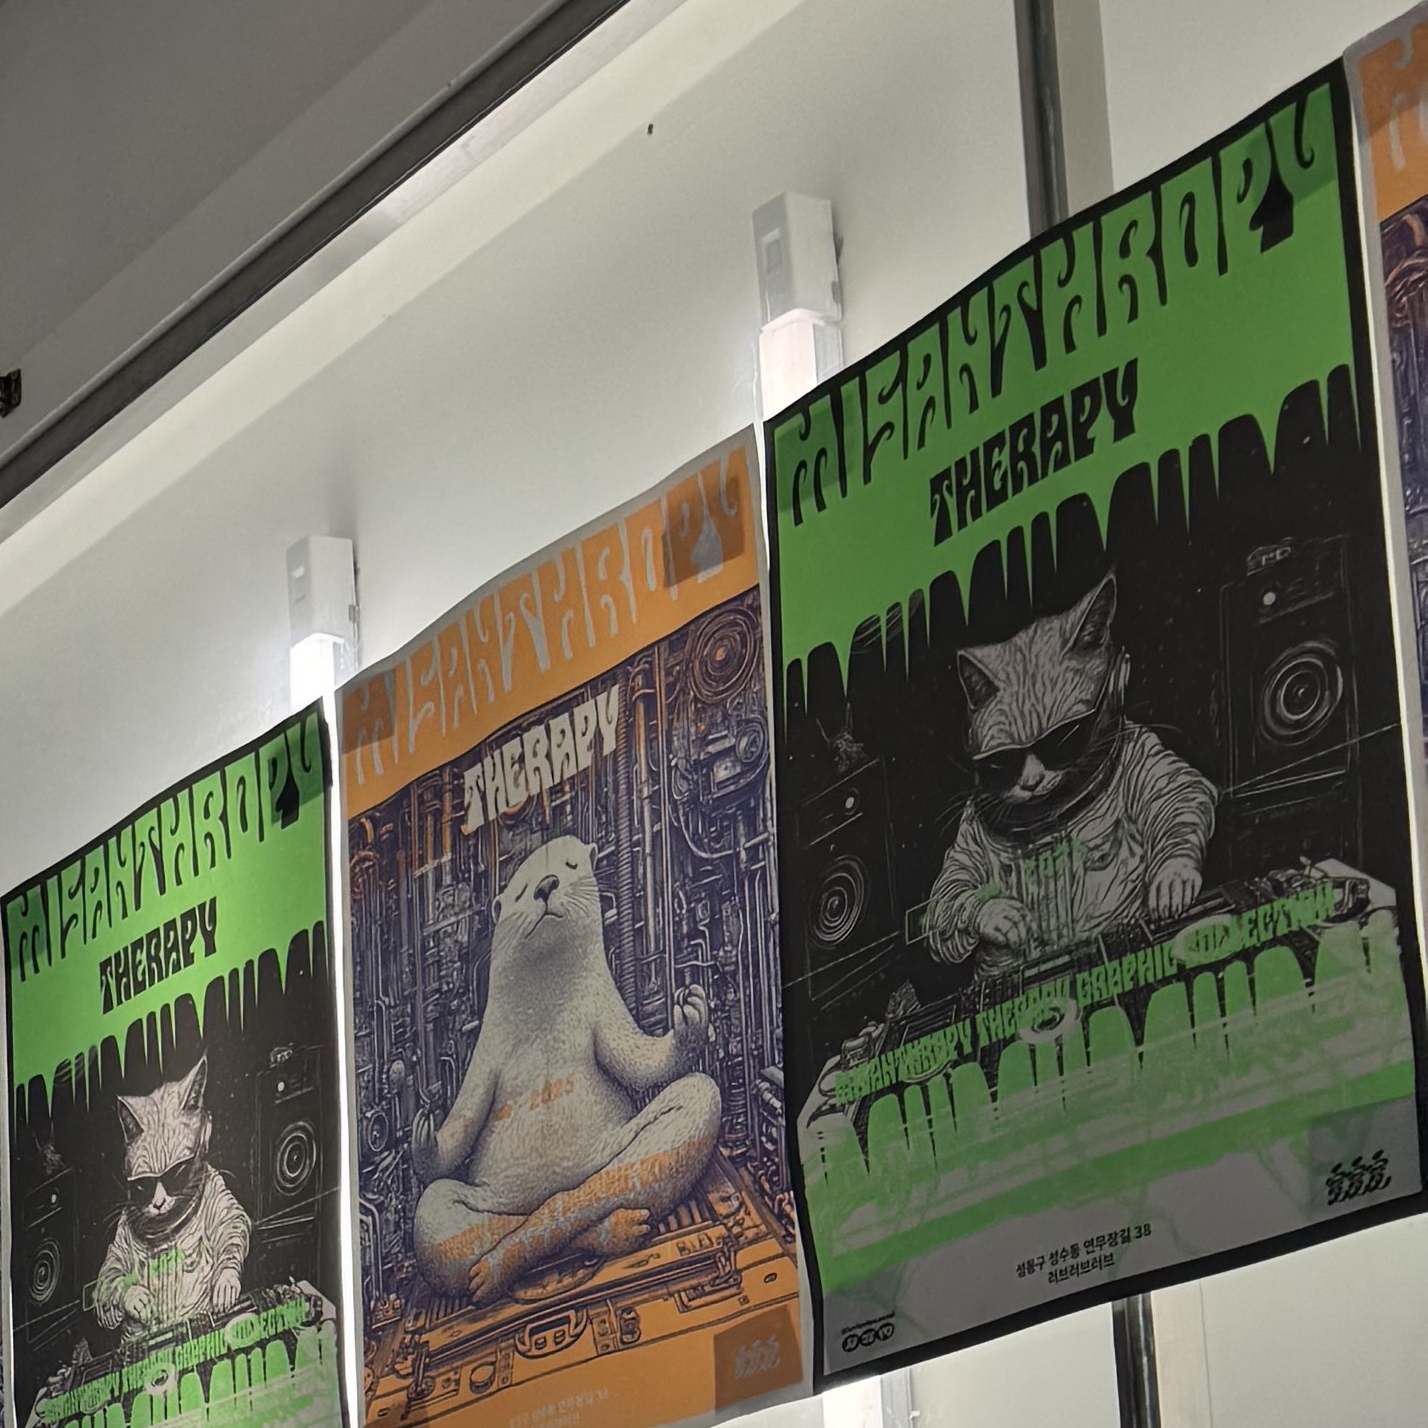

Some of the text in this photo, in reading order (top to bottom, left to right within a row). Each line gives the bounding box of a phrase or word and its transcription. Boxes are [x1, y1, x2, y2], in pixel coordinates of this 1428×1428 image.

[929, 357, 1139, 546] THERAPY
[460, 684, 620, 835] THERAPY
[99, 896, 217, 1015] THERAPY
[1048, 1242, 1081, 1266] 성수동
[1083, 1226, 1133, 1255] 연무장길
[1134, 1223, 1152, 1239] 38
[1048, 1252, 1115, 1284] 러브러브러브
